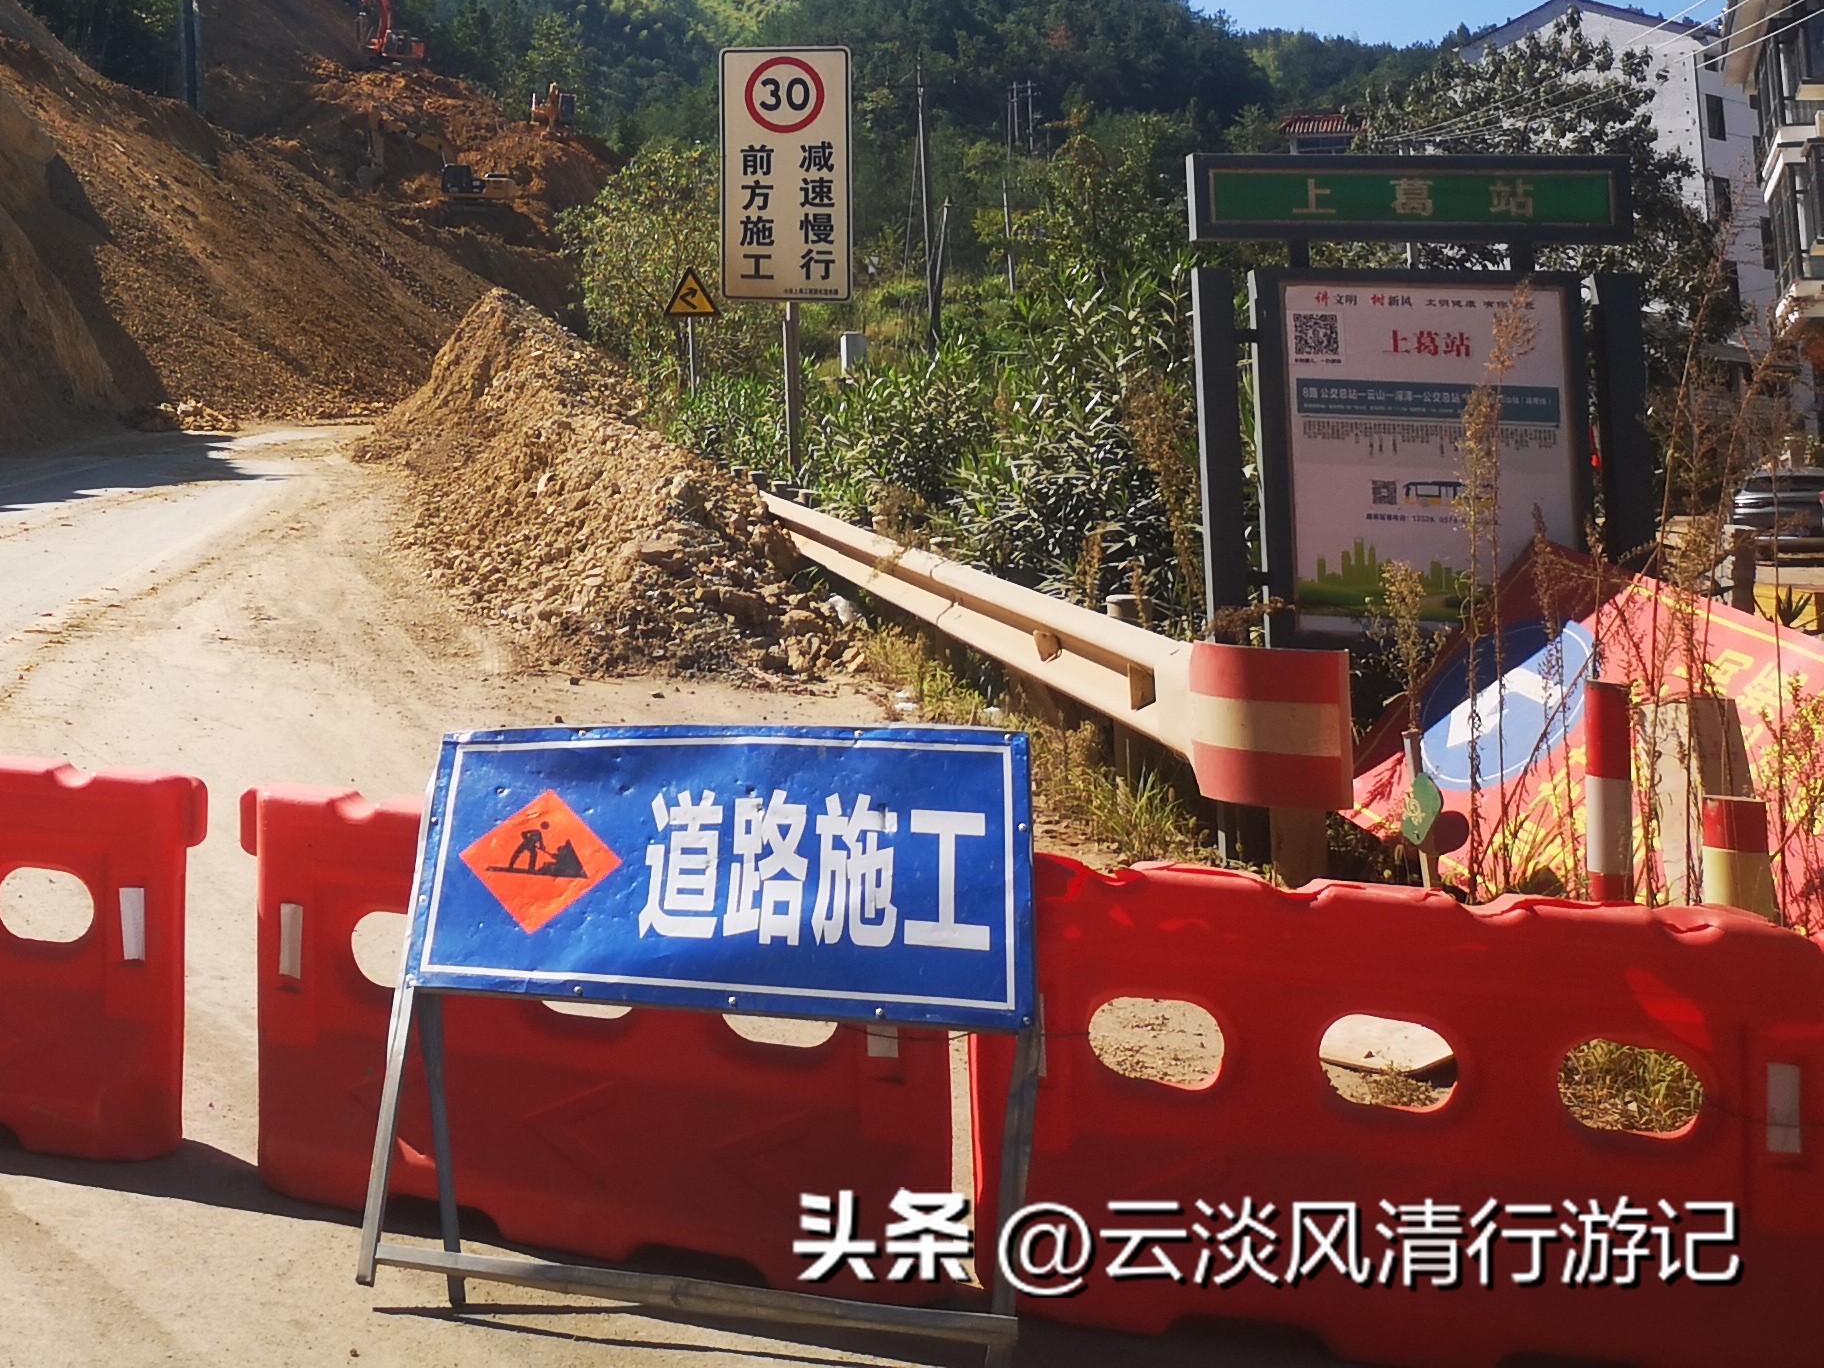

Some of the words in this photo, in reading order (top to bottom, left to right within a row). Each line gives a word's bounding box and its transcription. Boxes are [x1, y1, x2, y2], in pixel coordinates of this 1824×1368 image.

[759, 77, 810, 112] 30
[740, 144, 775, 281] 前方施工
[798, 140, 836, 281] 减速慢行
[1292, 176, 1534, 217] 上葛站
[1382, 329, 1471, 357] 上葛站
[638, 788, 992, 952] 道路施工
